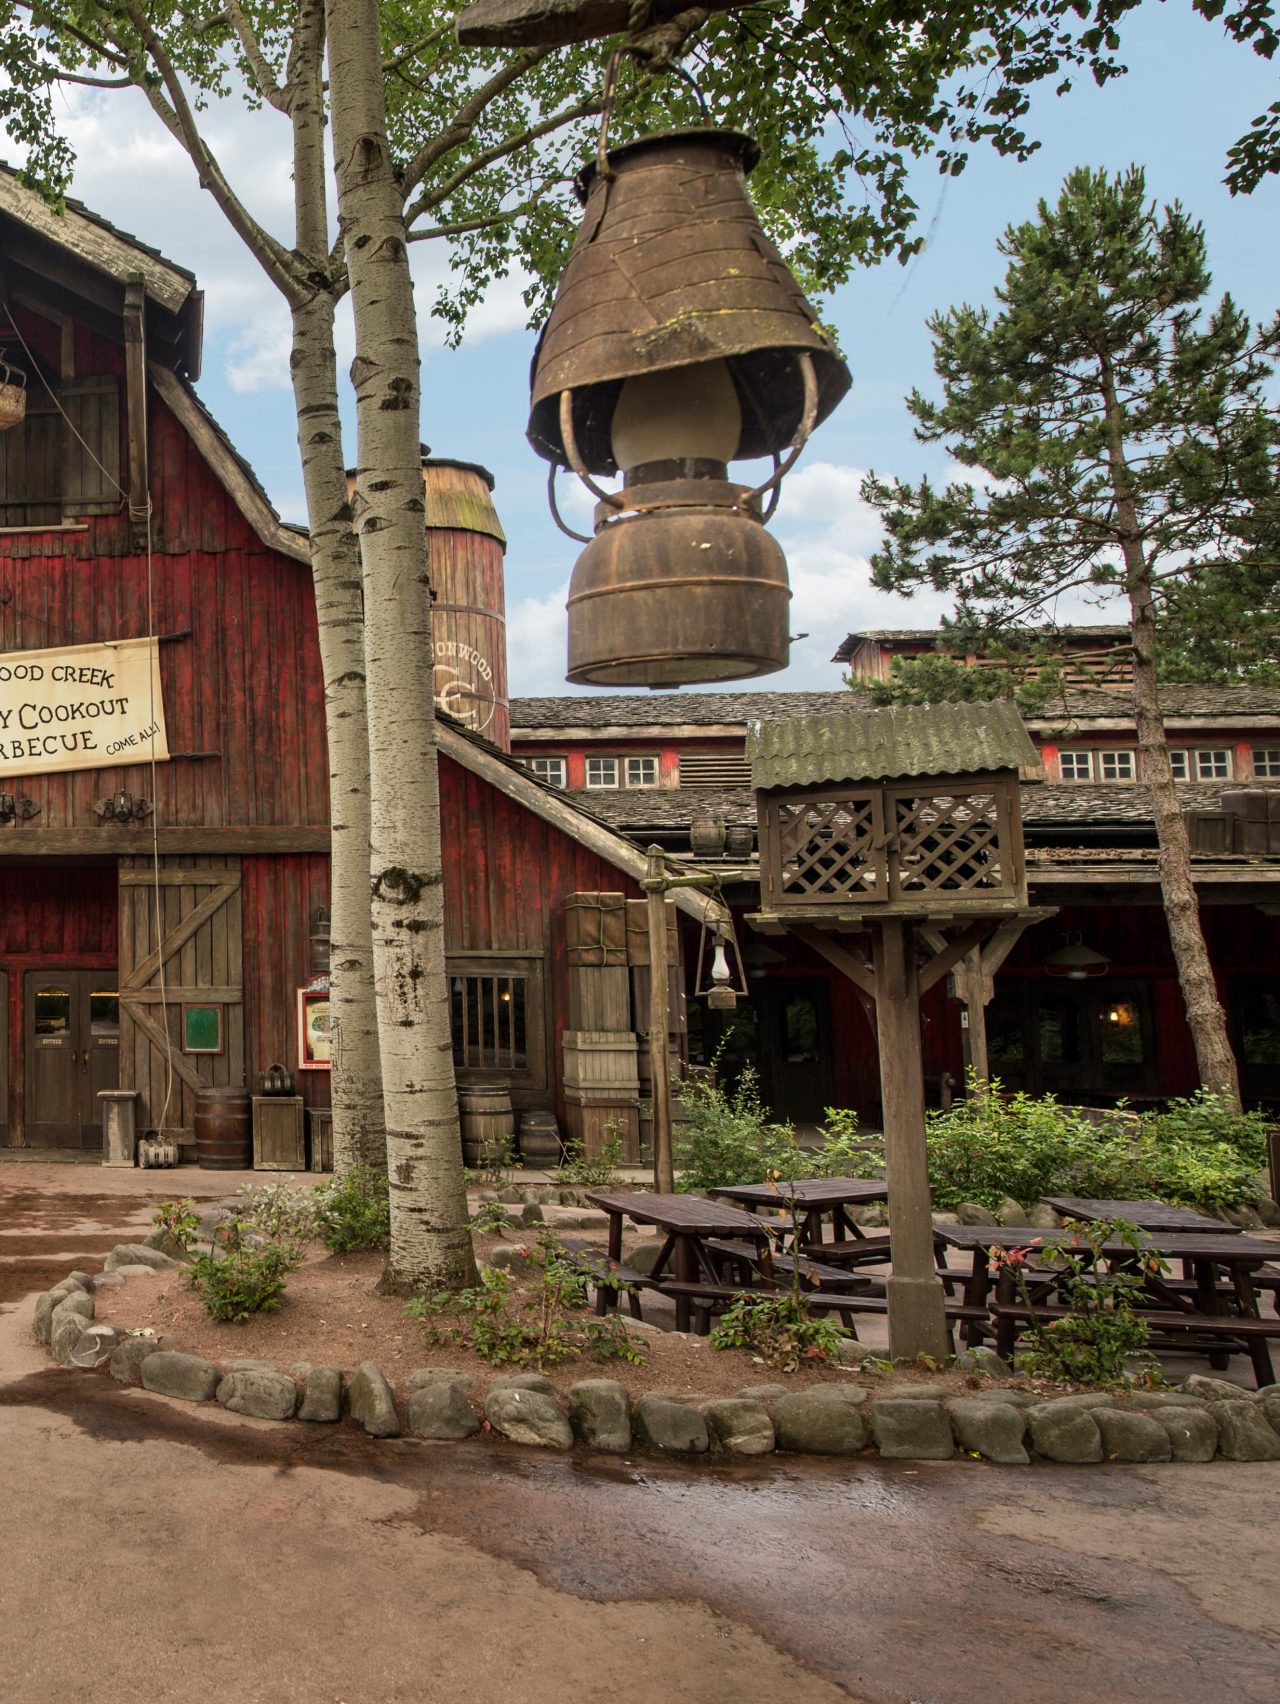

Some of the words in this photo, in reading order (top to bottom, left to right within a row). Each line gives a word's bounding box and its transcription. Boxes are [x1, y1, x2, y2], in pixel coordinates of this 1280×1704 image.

[51, 665, 115, 689] CREEK
[431, 641, 493, 681] ONWOOD
[18, 697, 129, 730] COOKOUT
[105, 734, 139, 756] COME
[138, 721, 161, 743] ALL!
